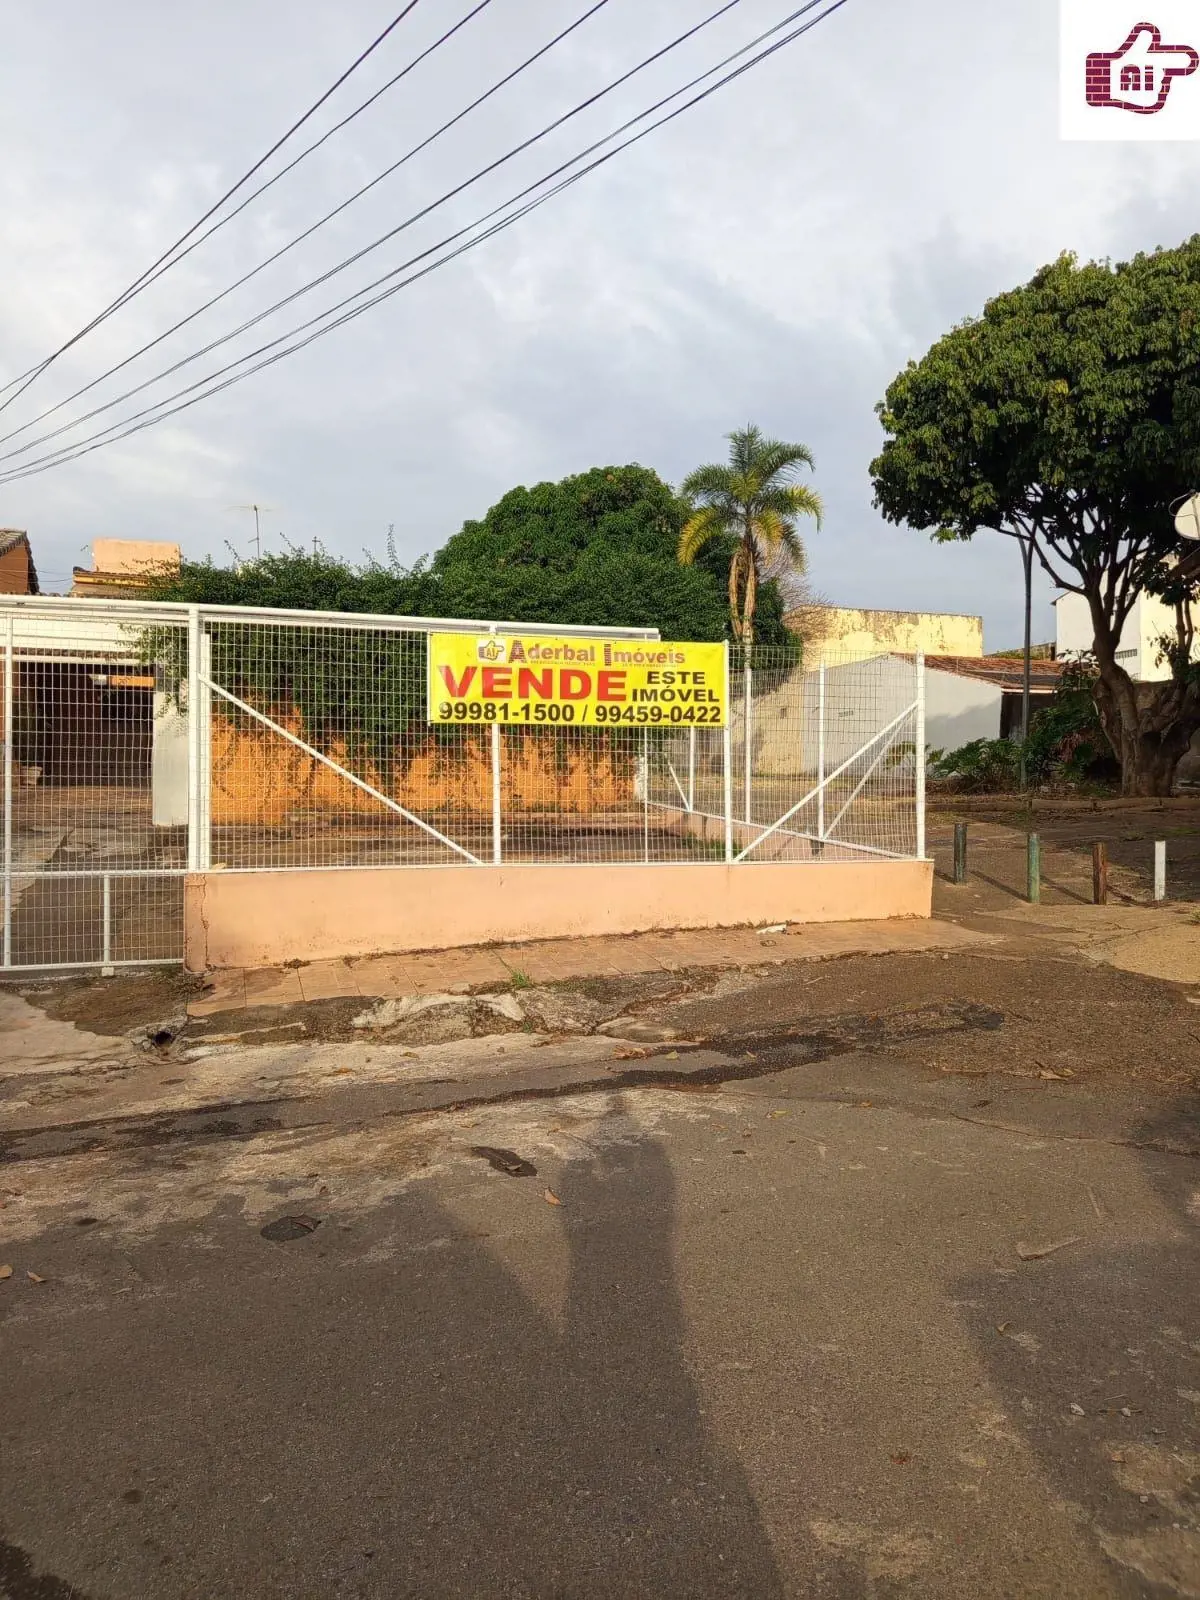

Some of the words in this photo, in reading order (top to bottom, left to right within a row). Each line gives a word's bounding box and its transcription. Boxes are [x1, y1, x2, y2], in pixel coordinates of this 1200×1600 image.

[508, 640, 595, 663] Aderbal
[604, 644, 686, 666] Imóveis
[439, 665, 628, 701] VENDE
[647, 671, 705, 685] ESTE
[632, 685, 720, 702] IMÓVEL
[439, 701, 575, 722] 99981-1500
[581, 704, 589, 722] /
[595, 704, 721, 723] 99459-0422
